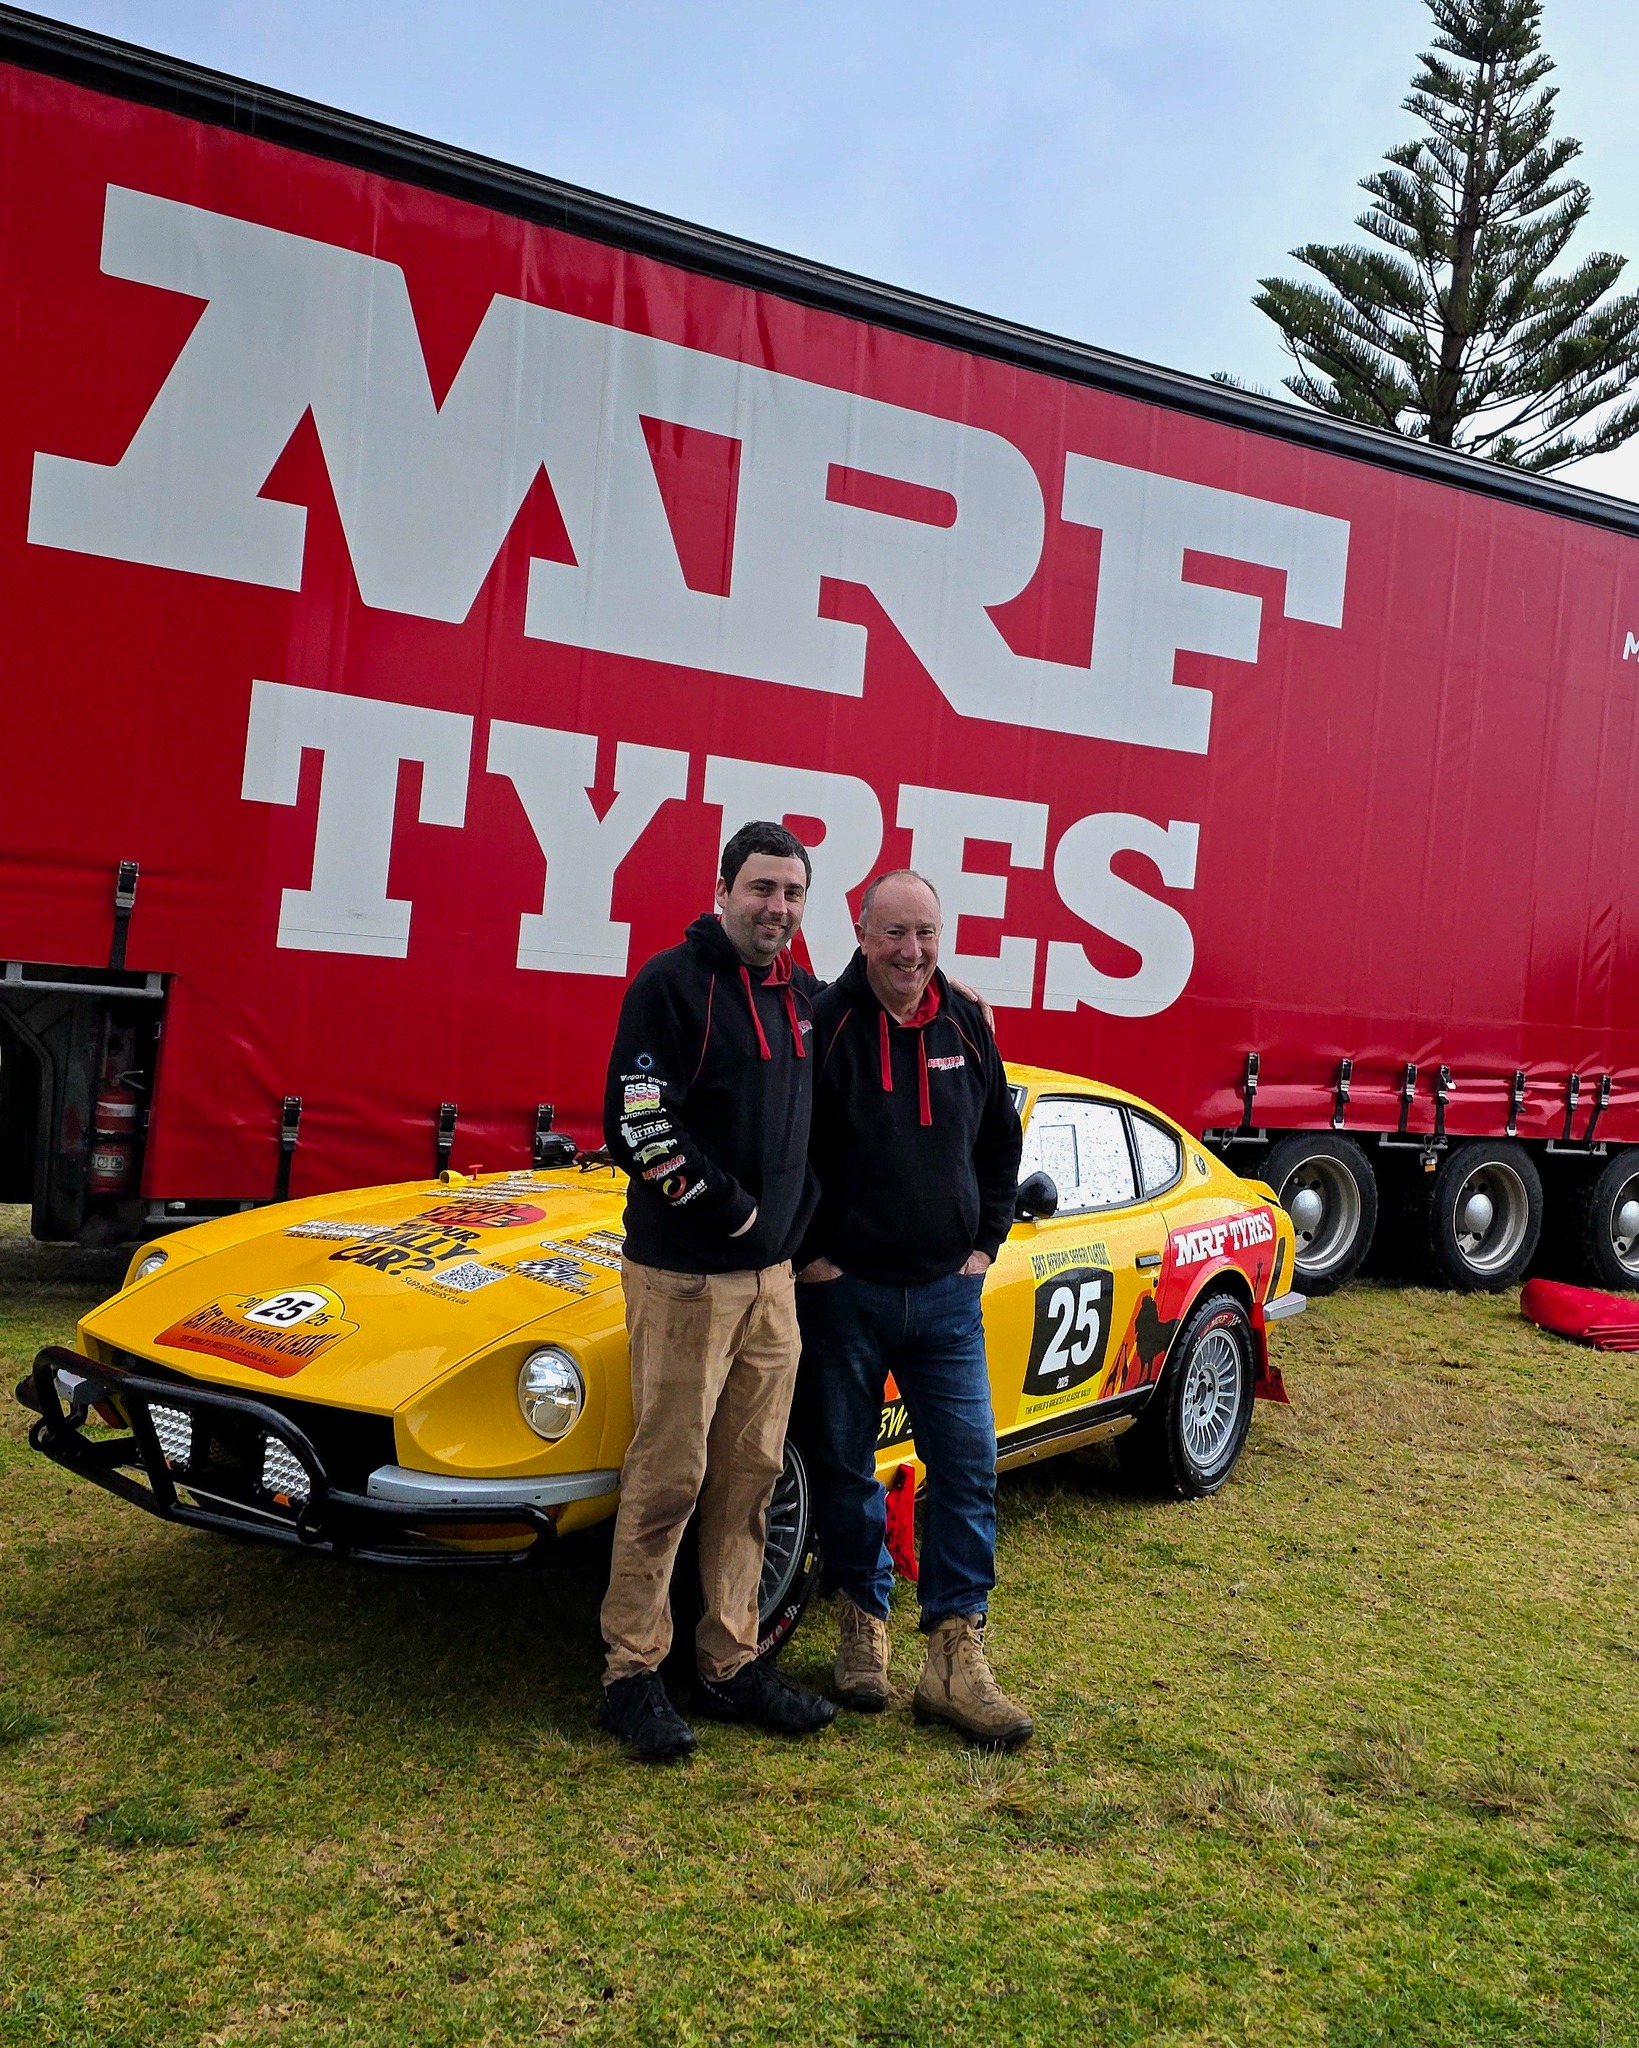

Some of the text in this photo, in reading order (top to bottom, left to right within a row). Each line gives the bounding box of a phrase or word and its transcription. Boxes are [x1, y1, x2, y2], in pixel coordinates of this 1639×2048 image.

[26, 183, 1350, 755] MRF
[241, 679, 1200, 1018] TYRES
[357, 1231, 482, 1261] RALLY
[1173, 1211, 1273, 1268] MRF TYRES
[328, 1244, 435, 1275] CAR?
[401, 1276, 447, 1299] SUPPORTERS
[488, 1261, 592, 1297] RALLYTRAVELS.COM
[236, 1296, 335, 1327] 20 25 25
[1037, 1279, 1102, 1376] 25
[238, 1327, 287, 1350] SAFARI
[273, 1332, 341, 1359] CLASSIC
[1056, 1374, 1070, 1390] 2025
